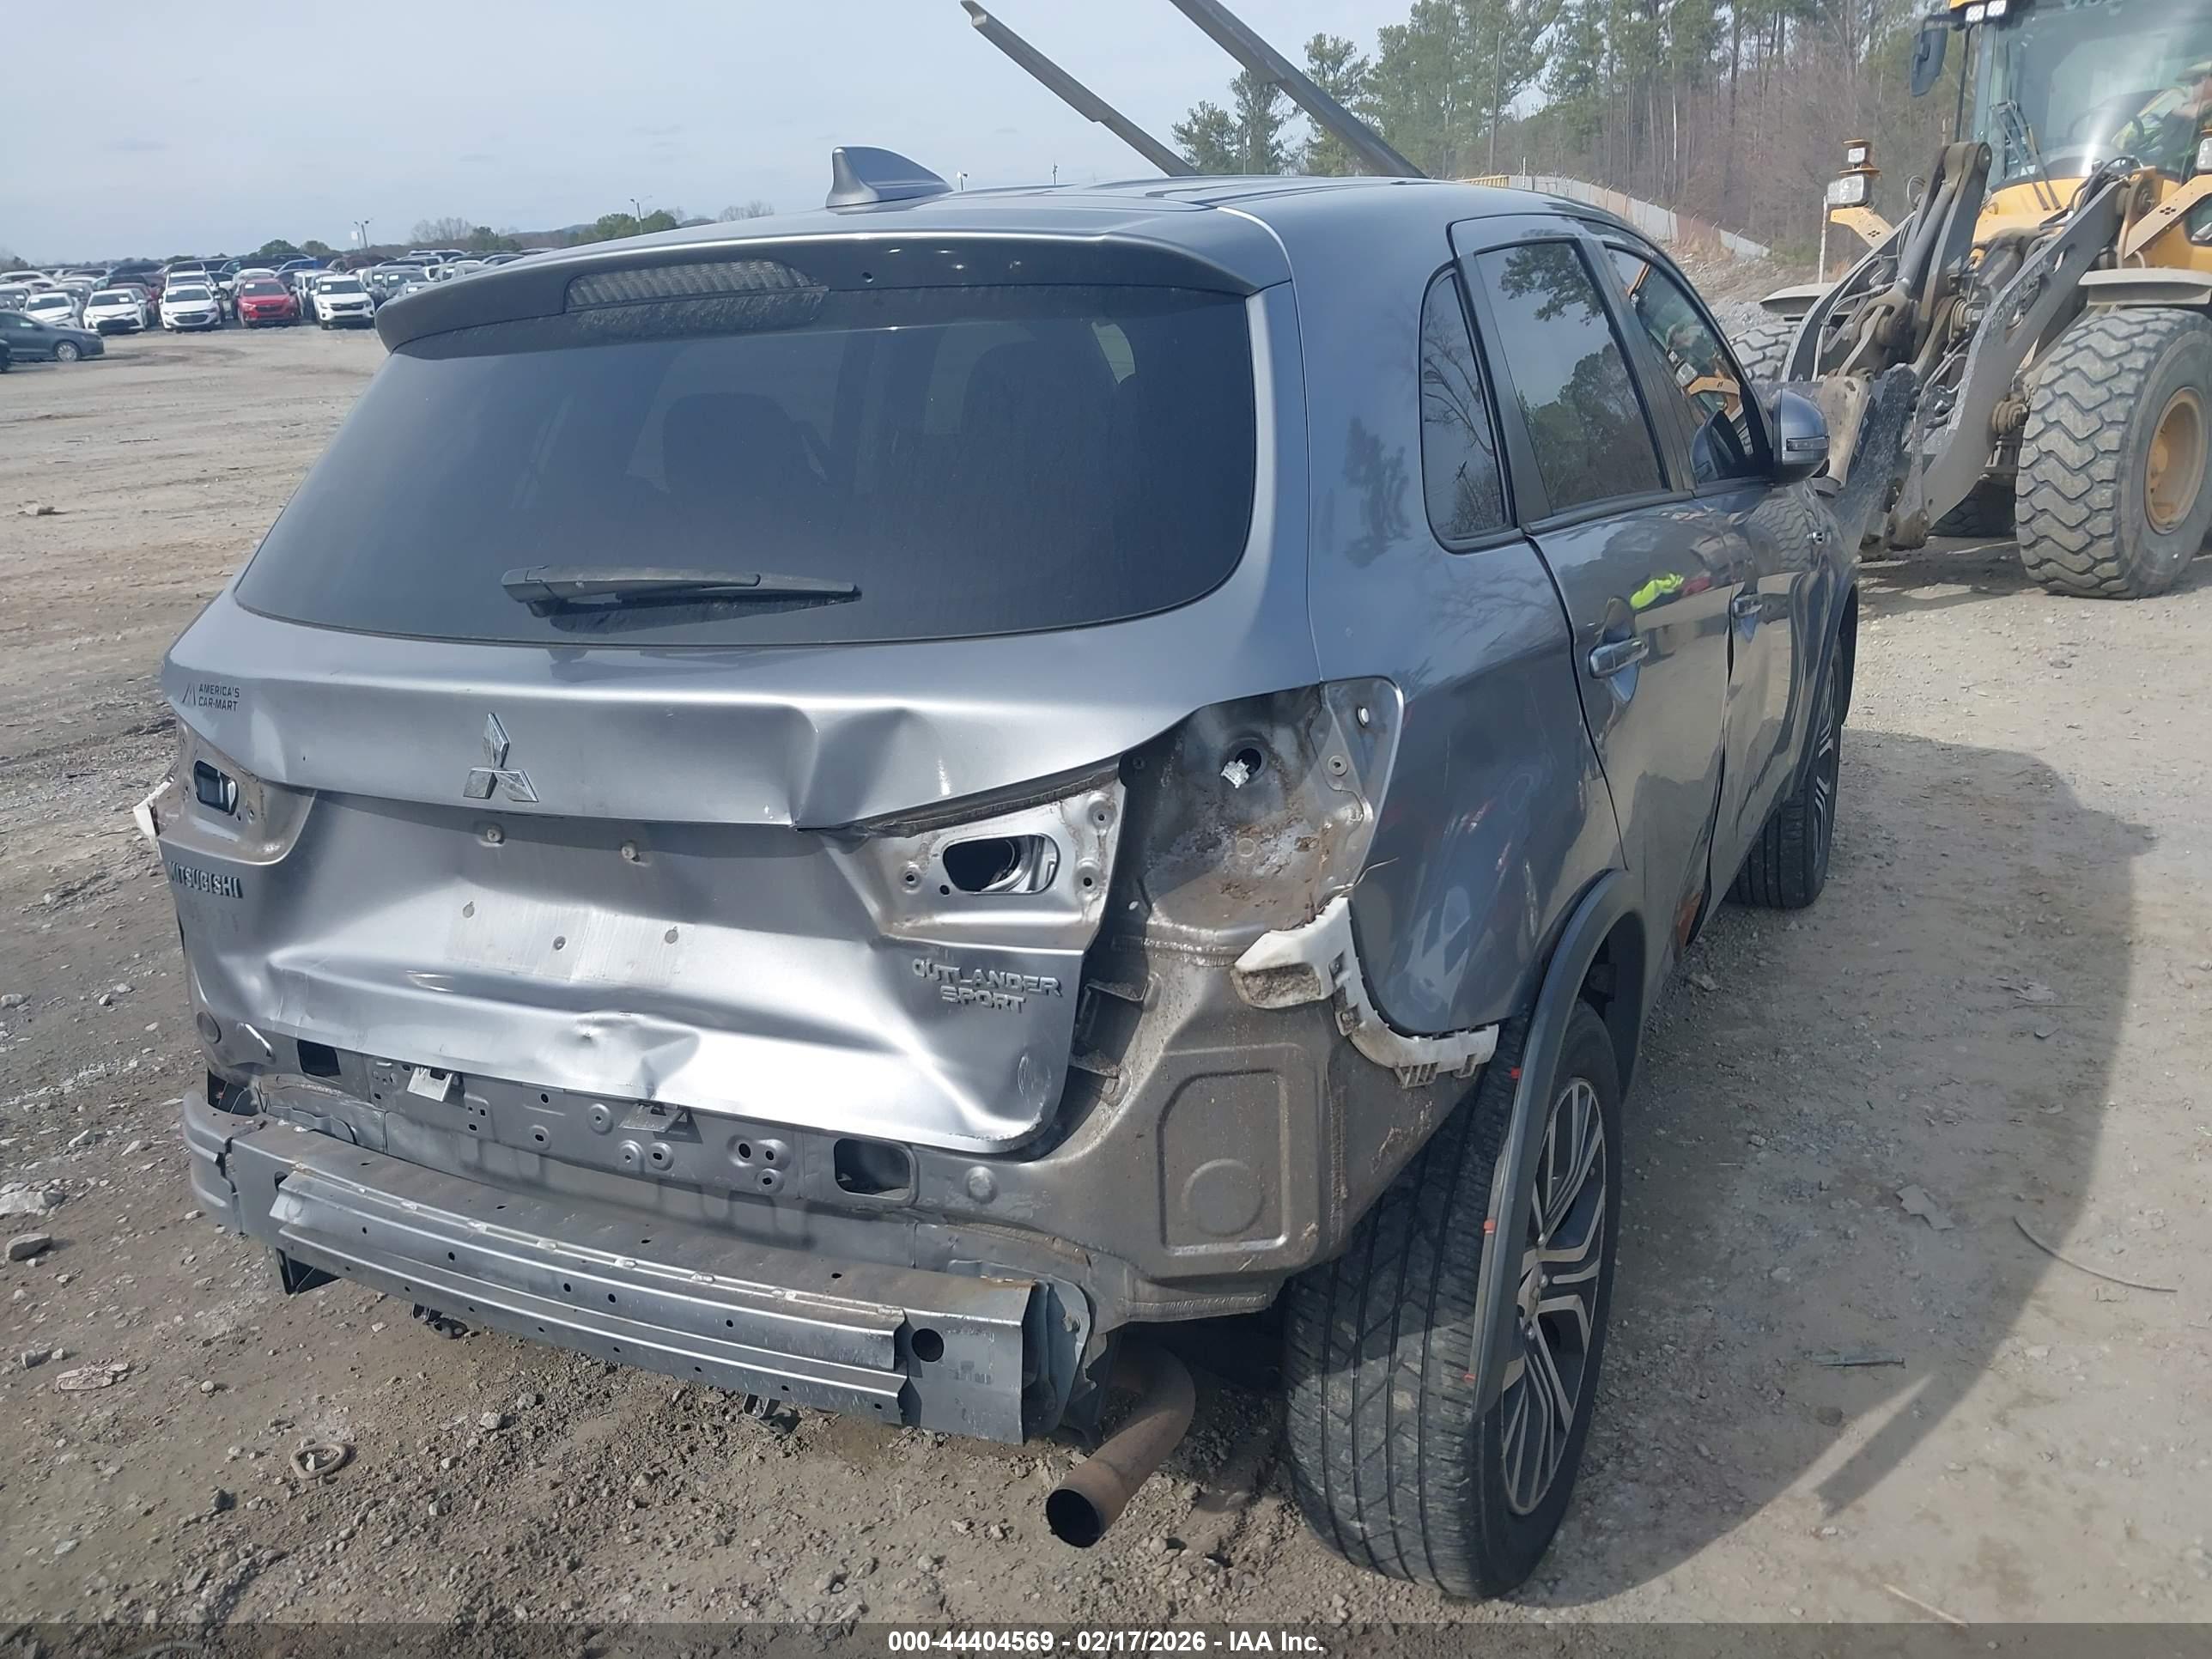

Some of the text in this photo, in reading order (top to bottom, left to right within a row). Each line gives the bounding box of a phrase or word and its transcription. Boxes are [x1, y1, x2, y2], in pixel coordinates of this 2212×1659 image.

[198, 684, 240, 698] AMERICA'S
[912, 958, 1062, 997] OUTLANDER
[940, 985, 1027, 1013] SPORT
